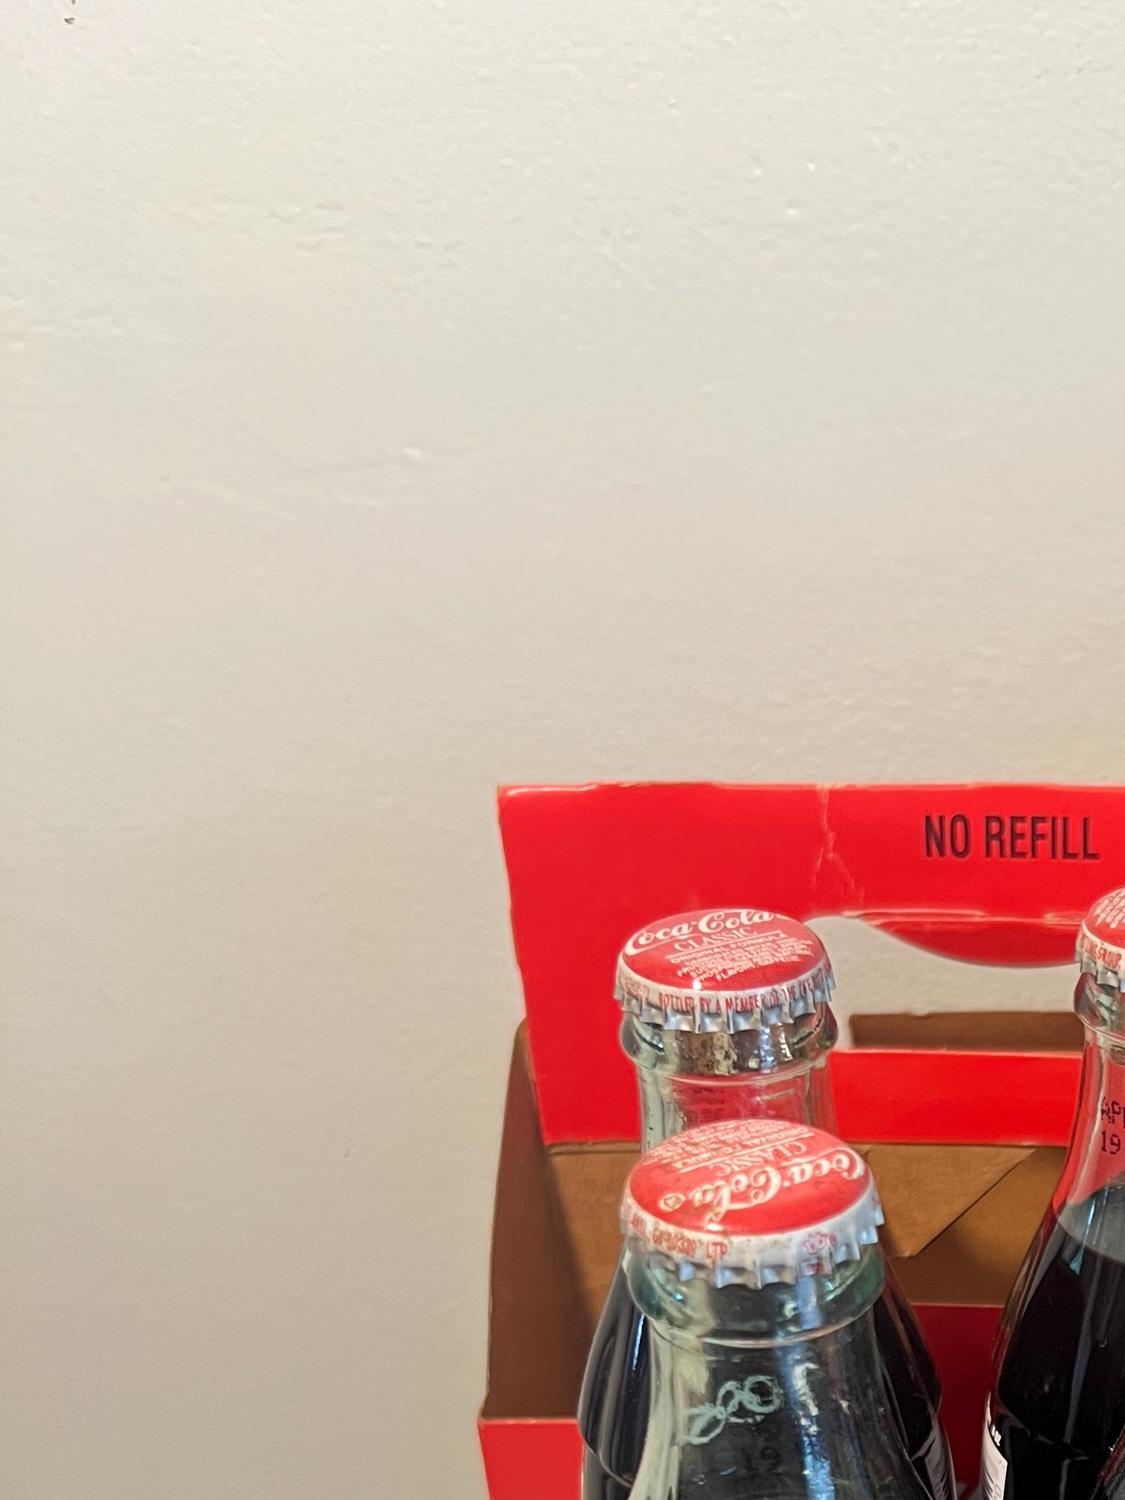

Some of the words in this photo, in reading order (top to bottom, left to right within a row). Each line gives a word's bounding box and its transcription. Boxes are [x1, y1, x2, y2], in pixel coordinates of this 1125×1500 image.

[924, 814, 972, 858] NO
[984, 815, 1101, 861] REFILL
[625, 909, 774, 956] Coca-Cola
[674, 928, 757, 952] CLASSIC
[725, 992, 764, 1014] MEMBER
[708, 1141, 807, 1177] CLASSIC
[688, 1147, 867, 1229] Coca-Cola
